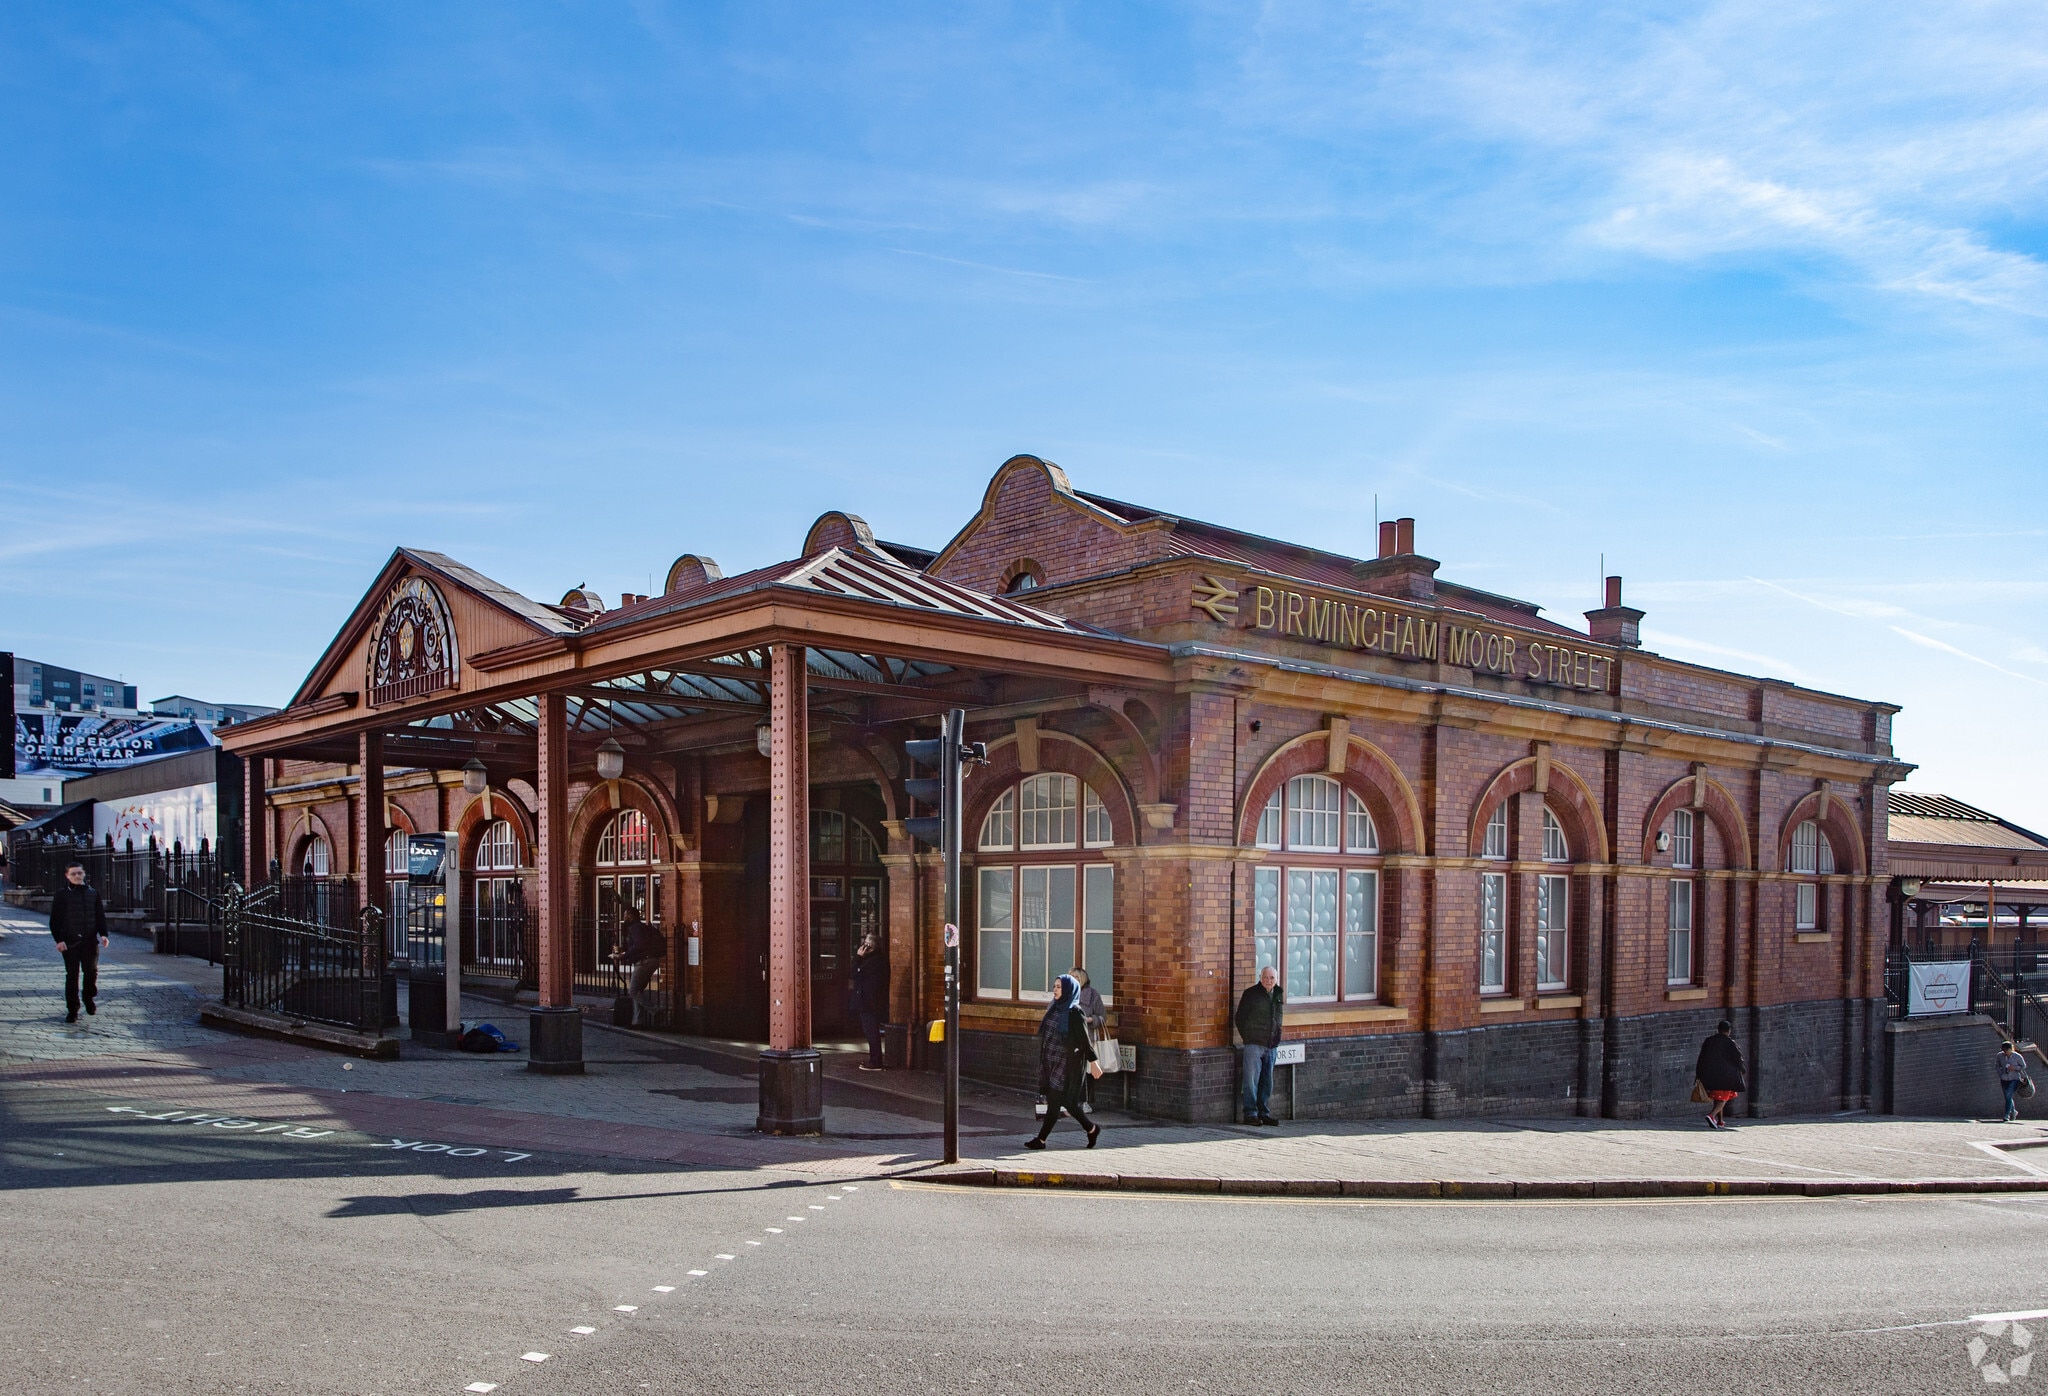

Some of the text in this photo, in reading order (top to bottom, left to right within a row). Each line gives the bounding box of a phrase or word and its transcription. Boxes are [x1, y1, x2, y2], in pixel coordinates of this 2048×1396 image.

[1256, 586, 1615, 691] BIRMINGHAM MOOR STREET
[61, 727, 98, 735] VOTED
[15, 733, 154, 750] RAIN OPERATOR
[24, 744, 47, 754] OF
[52, 745, 85, 756] THE
[1119, 1047, 1134, 1057] EET
[1276, 1050, 1287, 1060] OR
[1120, 1059, 1131, 1069] AY
[136, 1110, 531, 1163] LOOK RIGHT
